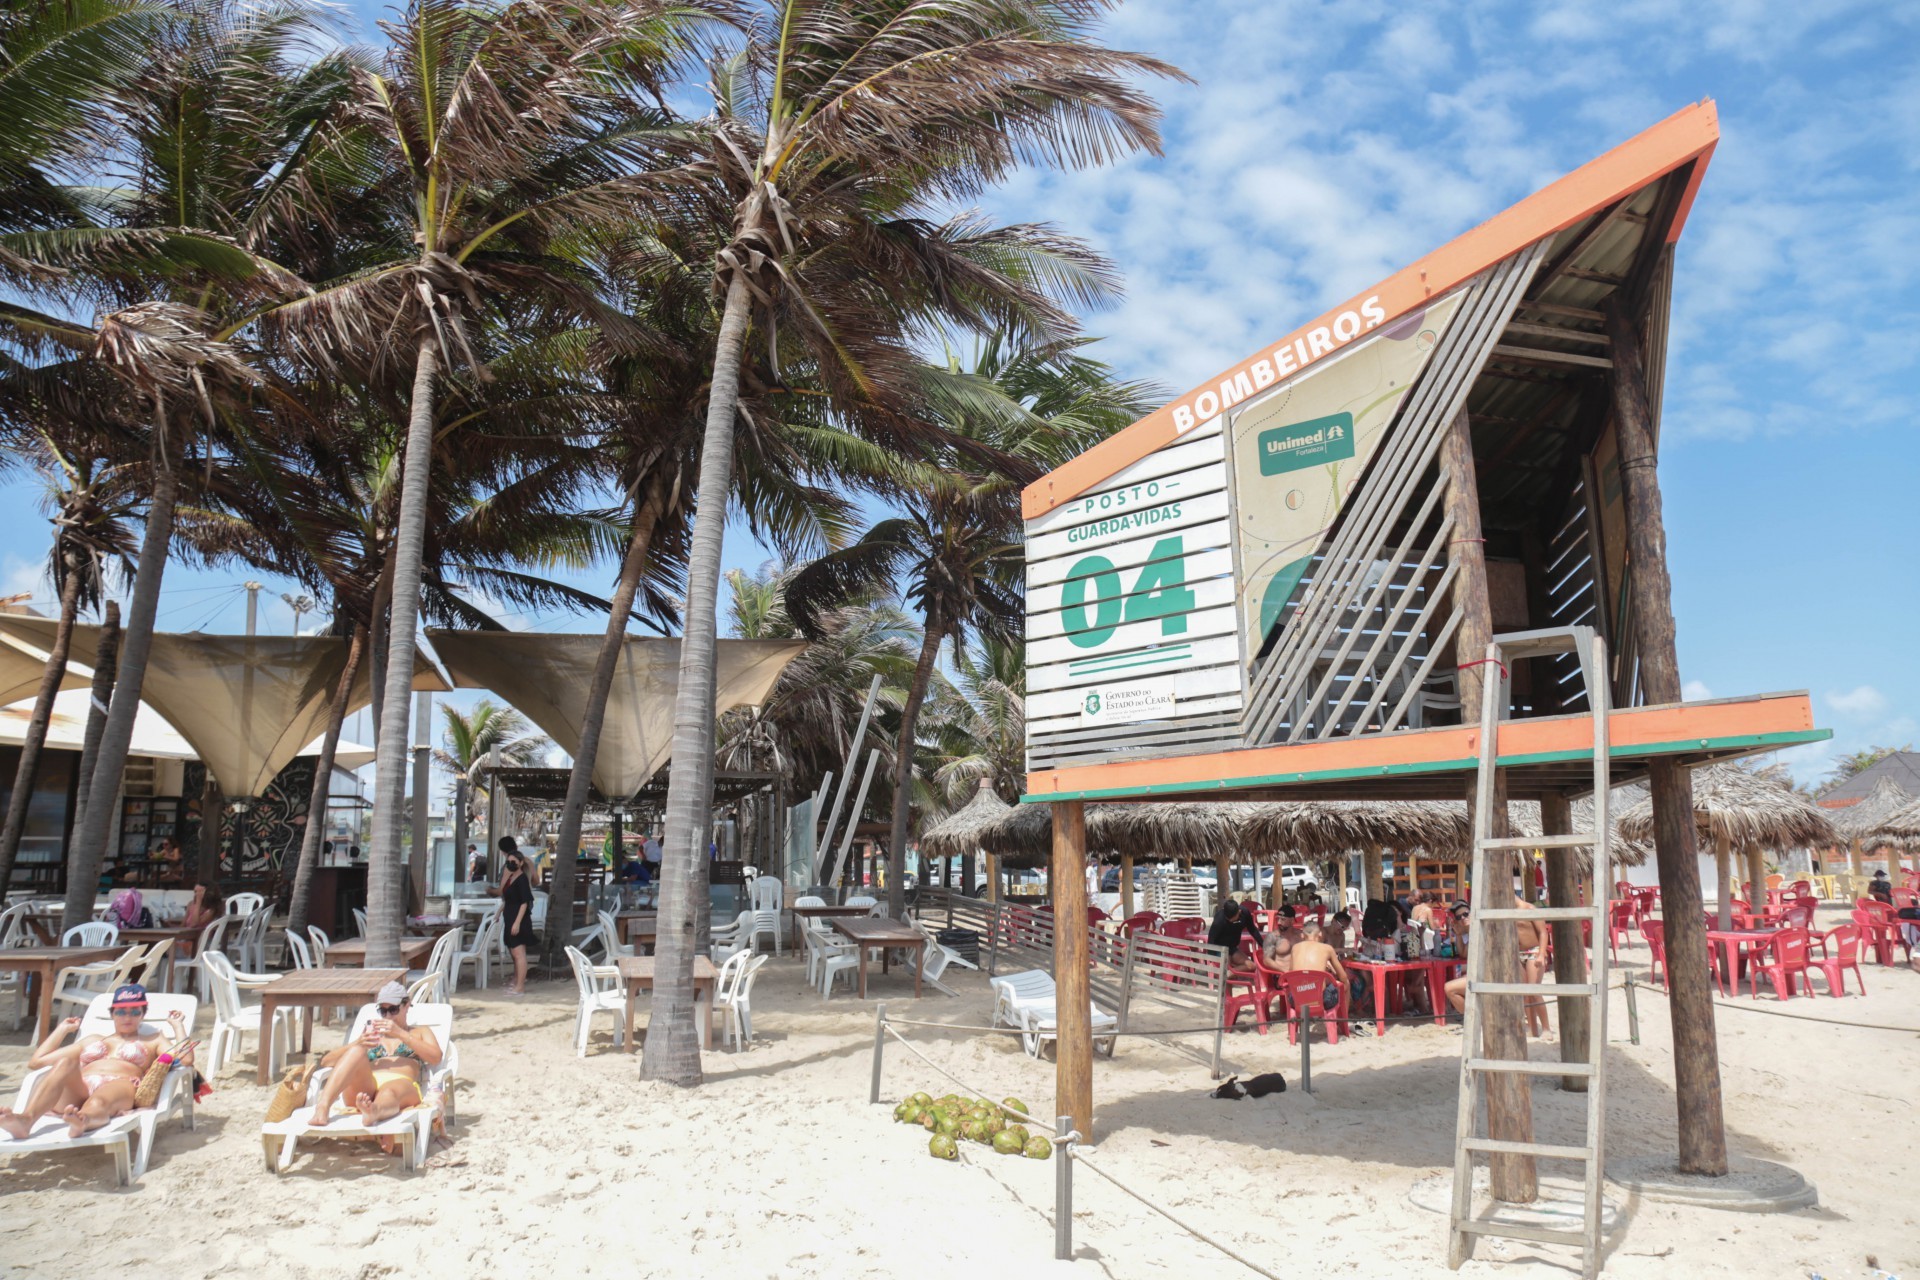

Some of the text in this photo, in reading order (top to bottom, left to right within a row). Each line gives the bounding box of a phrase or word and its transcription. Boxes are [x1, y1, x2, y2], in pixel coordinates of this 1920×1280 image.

[1172, 296, 1385, 434] BOMBEIROS
[1267, 429, 1323, 453] Unimed
[1296, 446, 1324, 456] Fortaleza
[1085, 482, 1159, 513] POSTO
[1067, 503, 1182, 543] GUARDA-VIDAS
[1061, 535, 1195, 648] 04
[1105, 690, 1142, 700] GOVERNO
[1106, 701, 1134, 710] ESTADO
